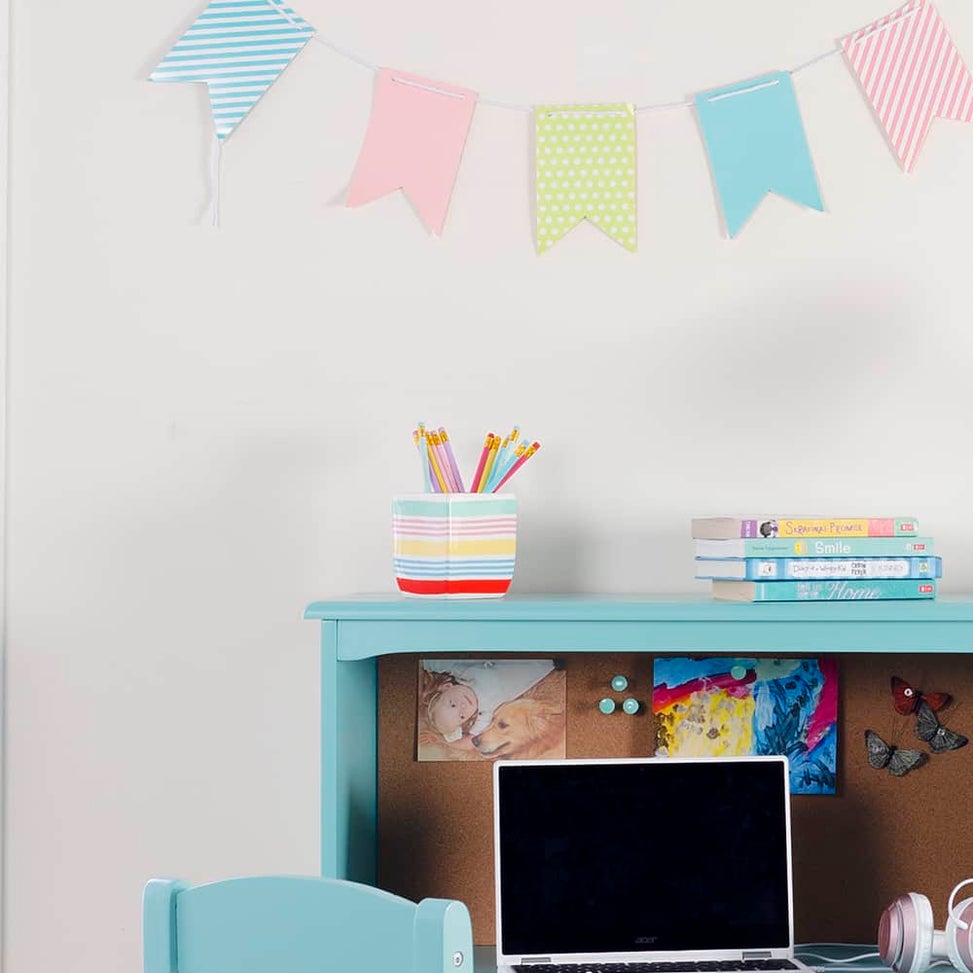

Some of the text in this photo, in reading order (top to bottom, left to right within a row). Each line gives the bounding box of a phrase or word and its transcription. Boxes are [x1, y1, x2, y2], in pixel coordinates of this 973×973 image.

[815, 541, 851, 554] Smile
[827, 581, 880, 600] Home
[635, 936, 657, 944] acer
